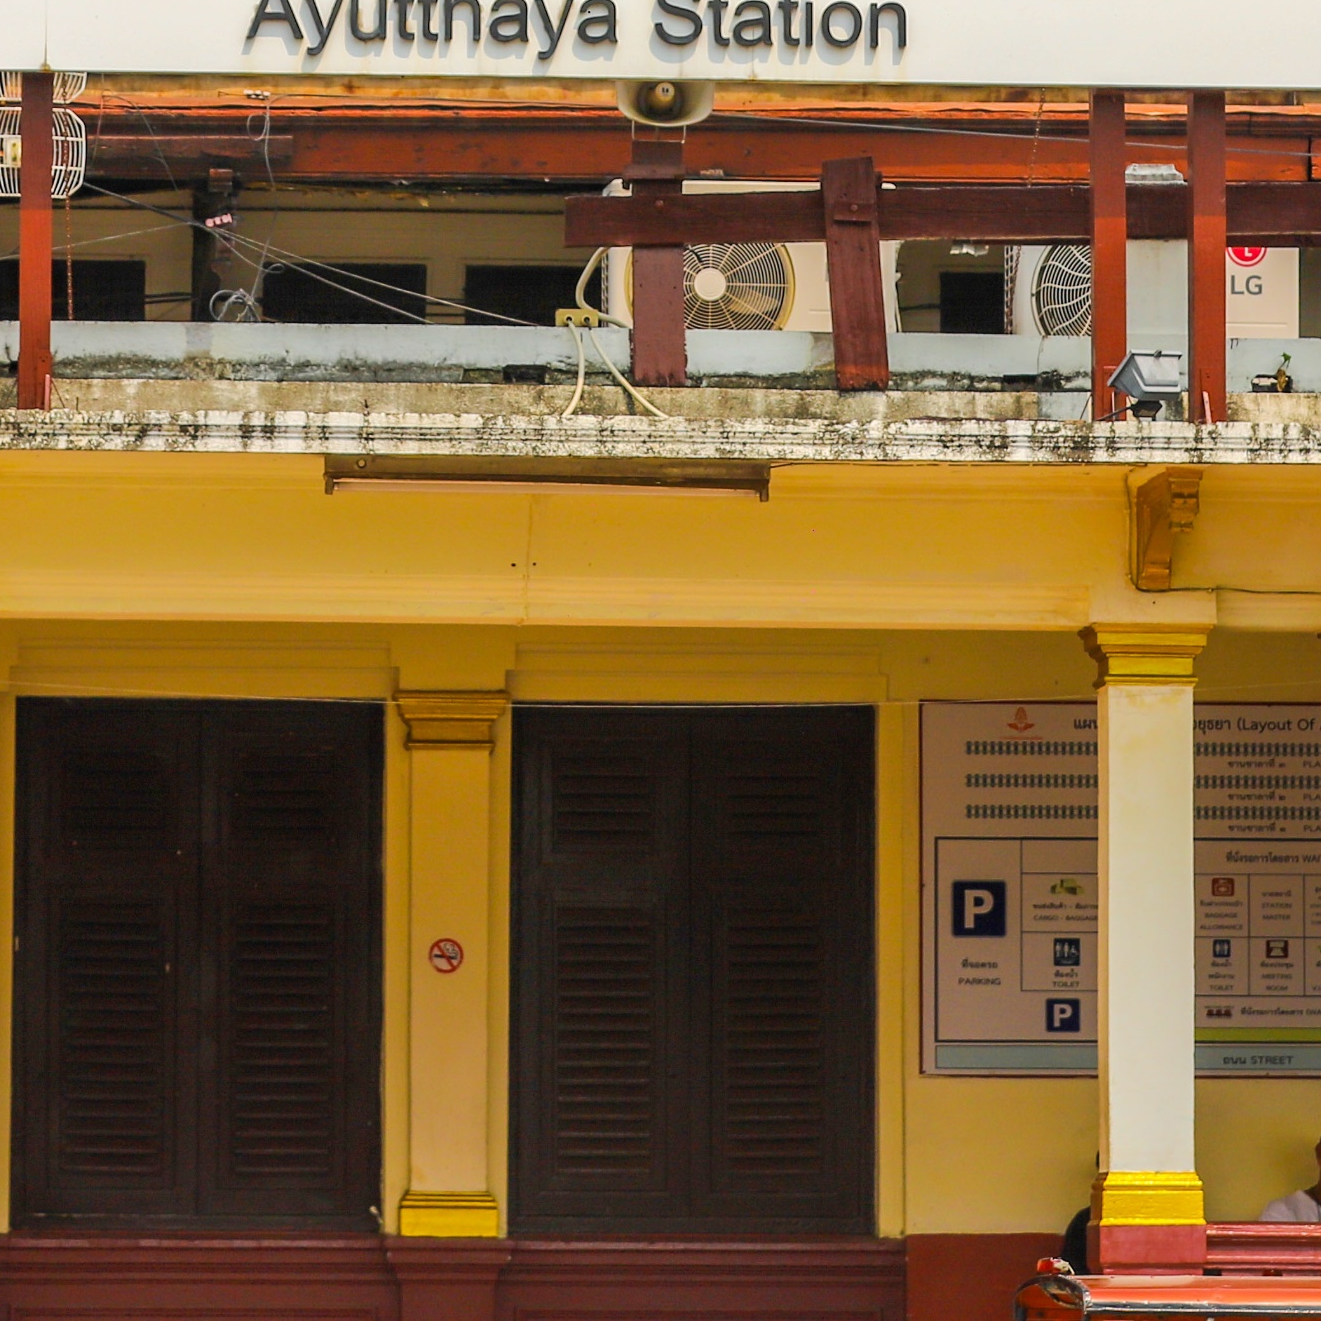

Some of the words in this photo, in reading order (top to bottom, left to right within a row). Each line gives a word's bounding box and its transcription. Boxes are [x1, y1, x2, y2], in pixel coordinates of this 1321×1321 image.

[1230, 274, 1263, 296] LG
[1297, 718, 1316, 729] Of
[963, 889, 995, 929] P
[958, 977, 1002, 986] PARKING
[1053, 1004, 1073, 1027] P
[1249, 1055, 1294, 1065] STREET
